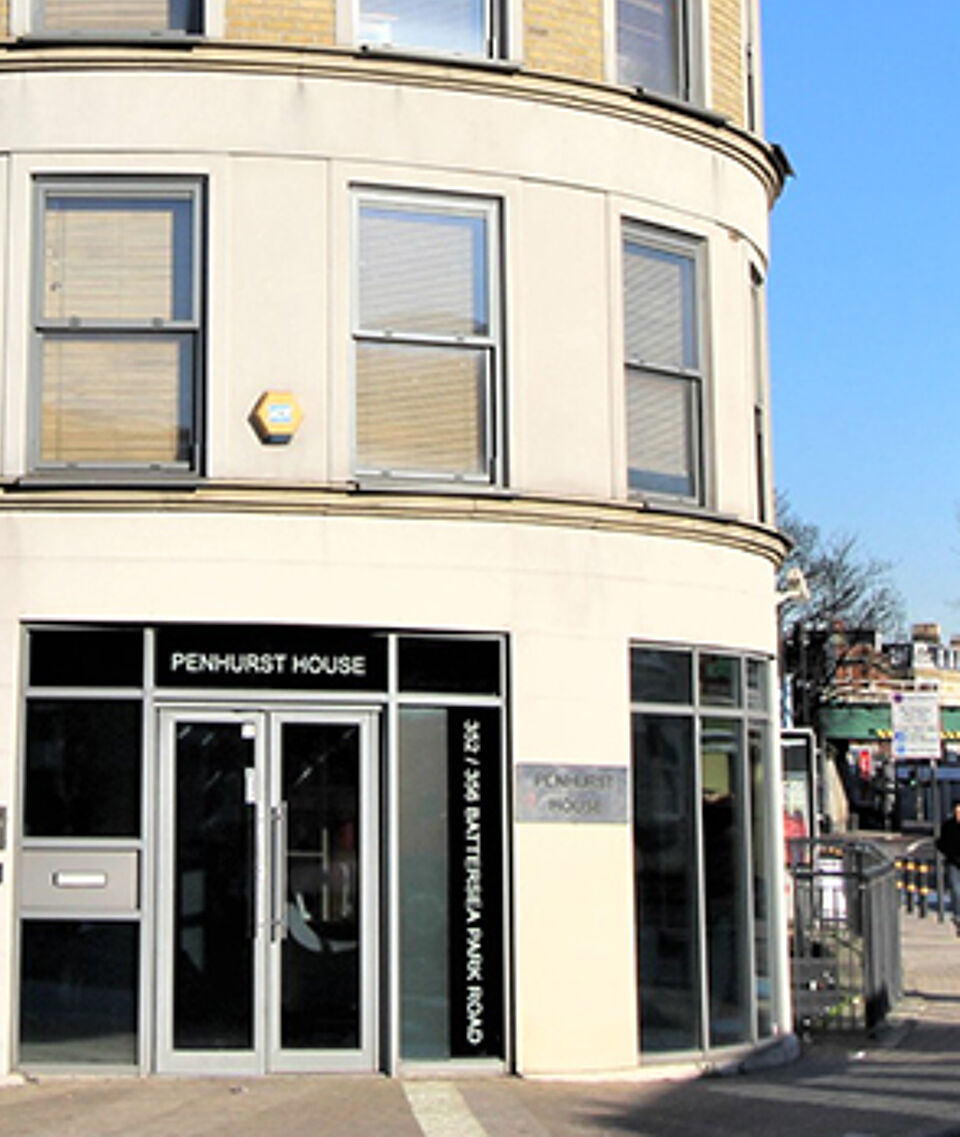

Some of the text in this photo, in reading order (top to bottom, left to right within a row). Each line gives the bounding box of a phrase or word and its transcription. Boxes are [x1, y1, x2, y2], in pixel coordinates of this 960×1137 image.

[171, 652, 367, 676] PENHURST HOUSE
[463, 806, 482, 924] BATTERSEA
[465, 927, 484, 981] PARK
[465, 985, 485, 1046] ROAD
